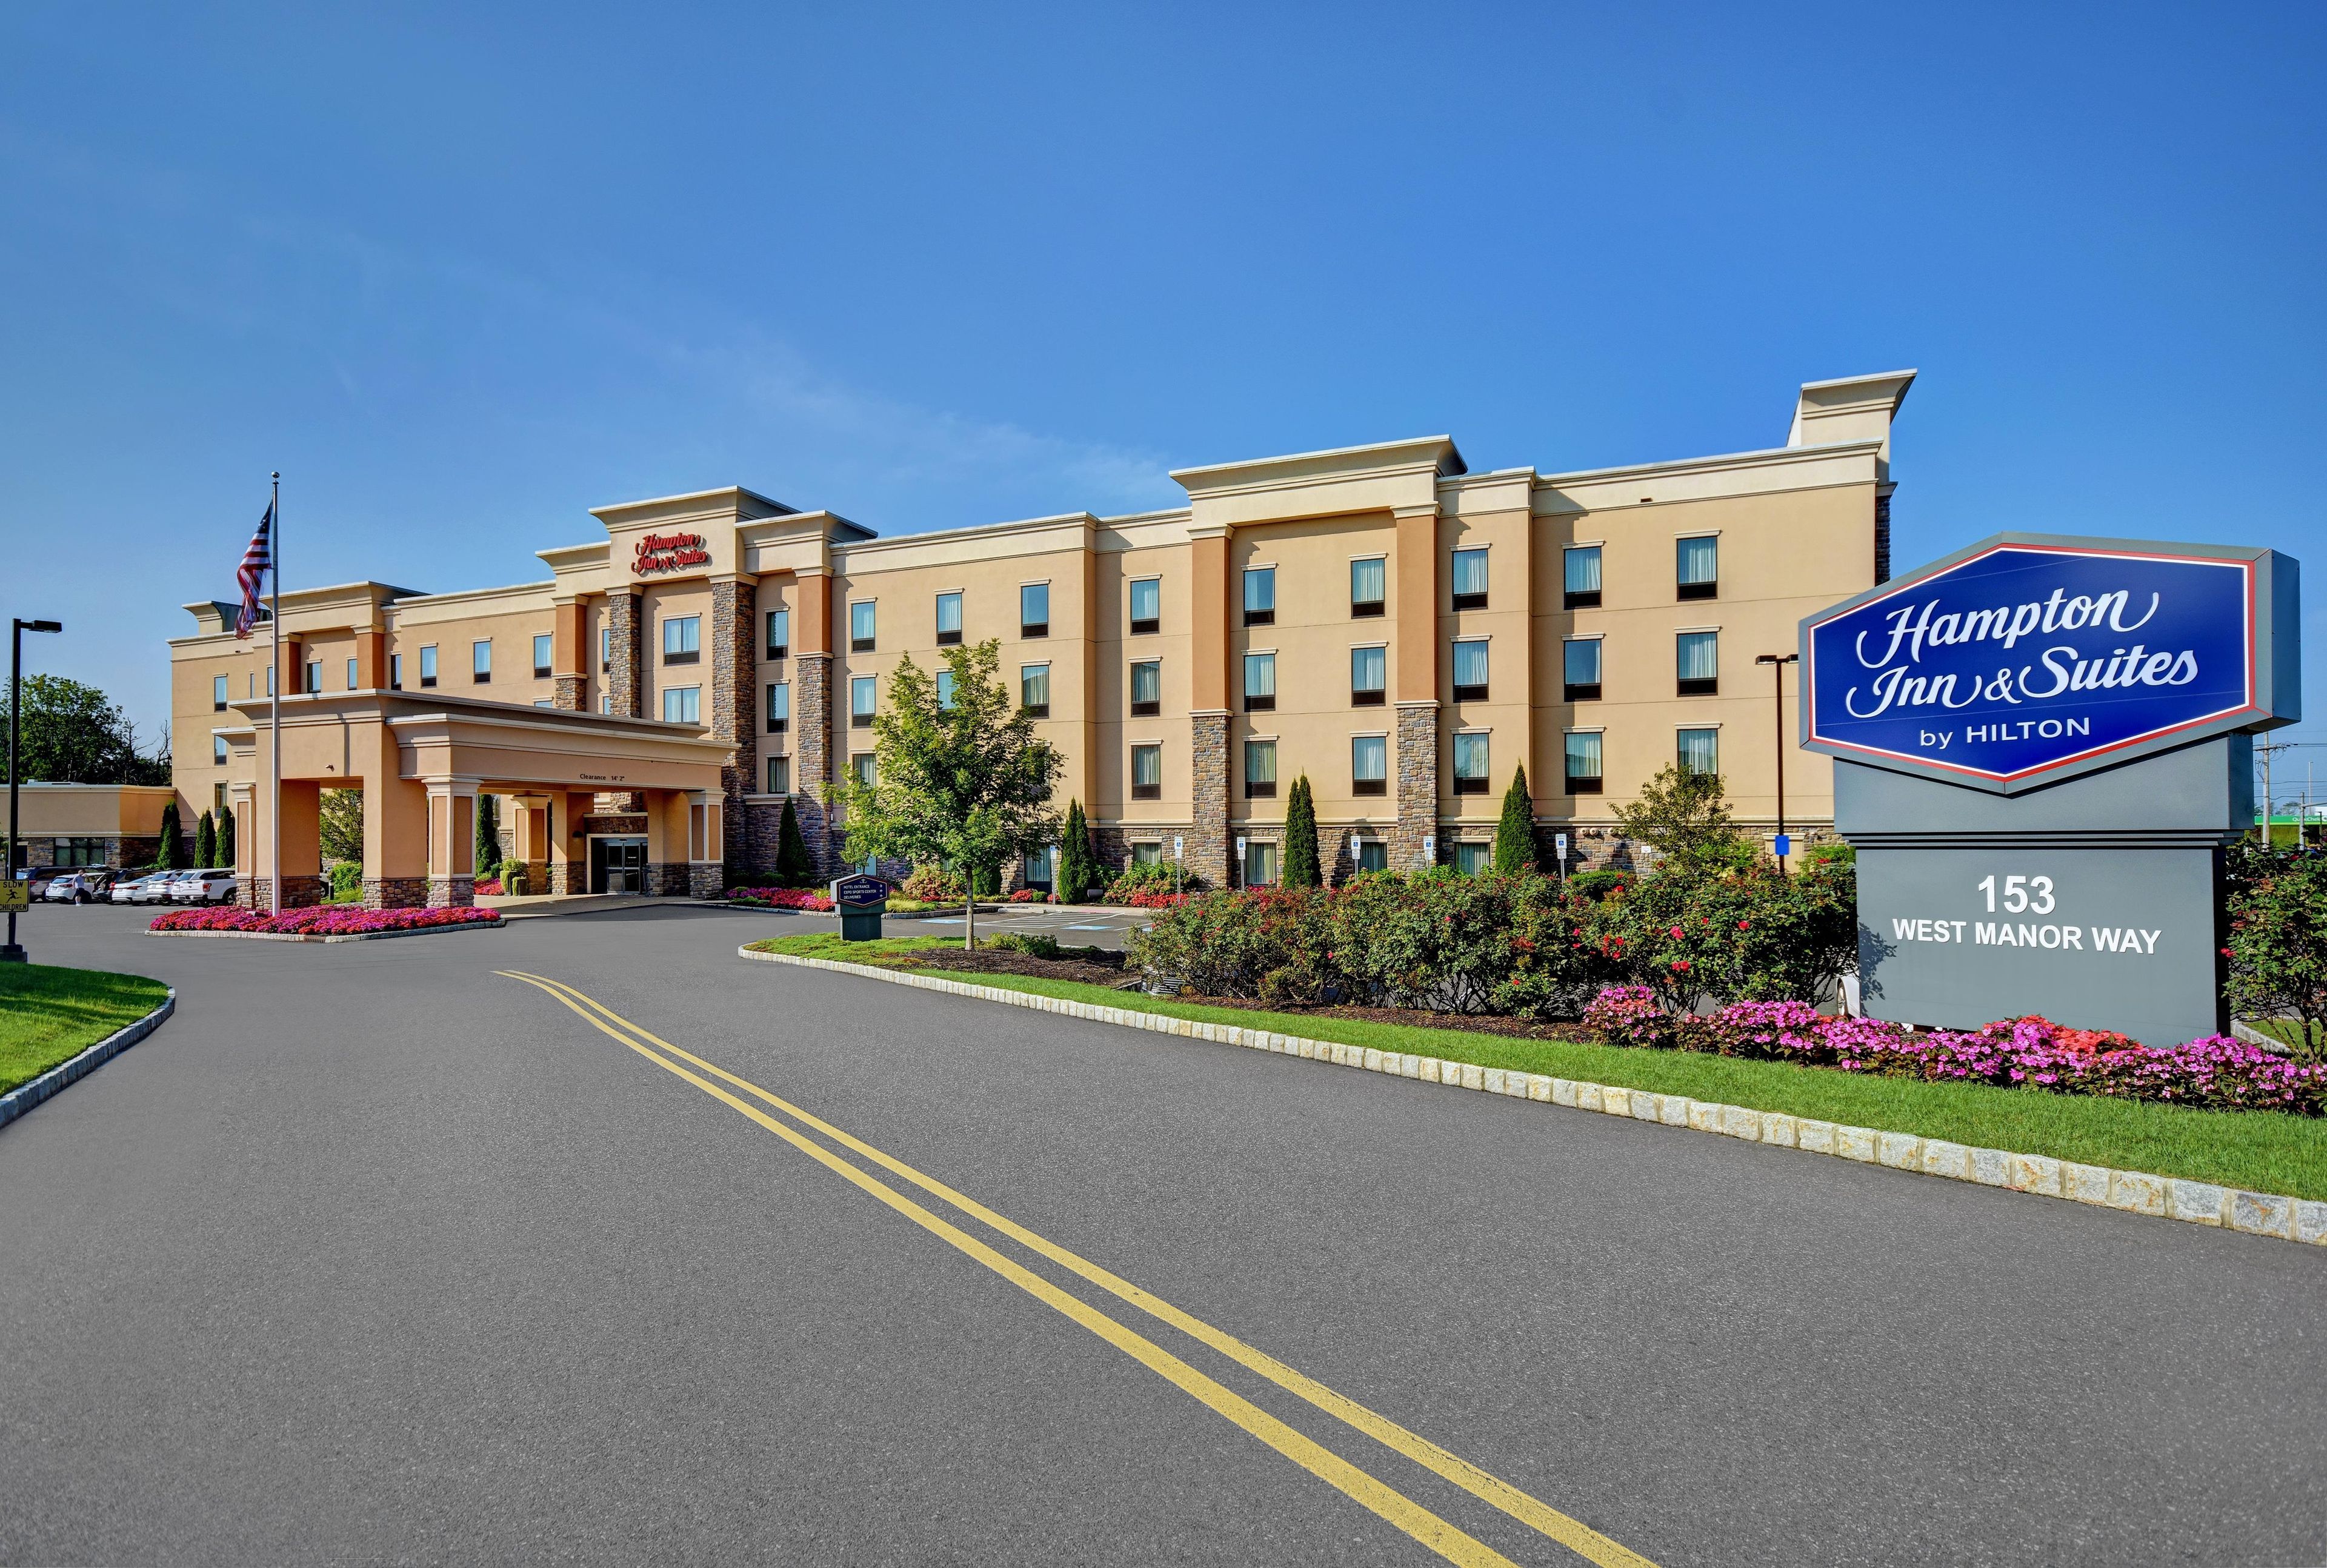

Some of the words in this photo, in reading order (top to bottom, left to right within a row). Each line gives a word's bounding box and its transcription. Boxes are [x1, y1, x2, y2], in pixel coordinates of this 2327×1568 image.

[631, 555, 663, 573] Inn
[662, 556, 671, 568] &
[670, 548, 708, 566] Suites
[635, 533, 701, 556] Hampton
[1856, 588, 2159, 668] Hampton
[1846, 666, 1982, 719] Inn
[1984, 668, 2022, 704] &
[2019, 645, 2198, 698] Suites
[1920, 729, 1953, 750] by
[1967, 717, 2090, 743] HILTON
[1978, 875, 2056, 915] 153
[1892, 918, 1968, 943] WEST
[1975, 922, 2085, 950] MANOR
[2091, 927, 2162, 954] WAY
